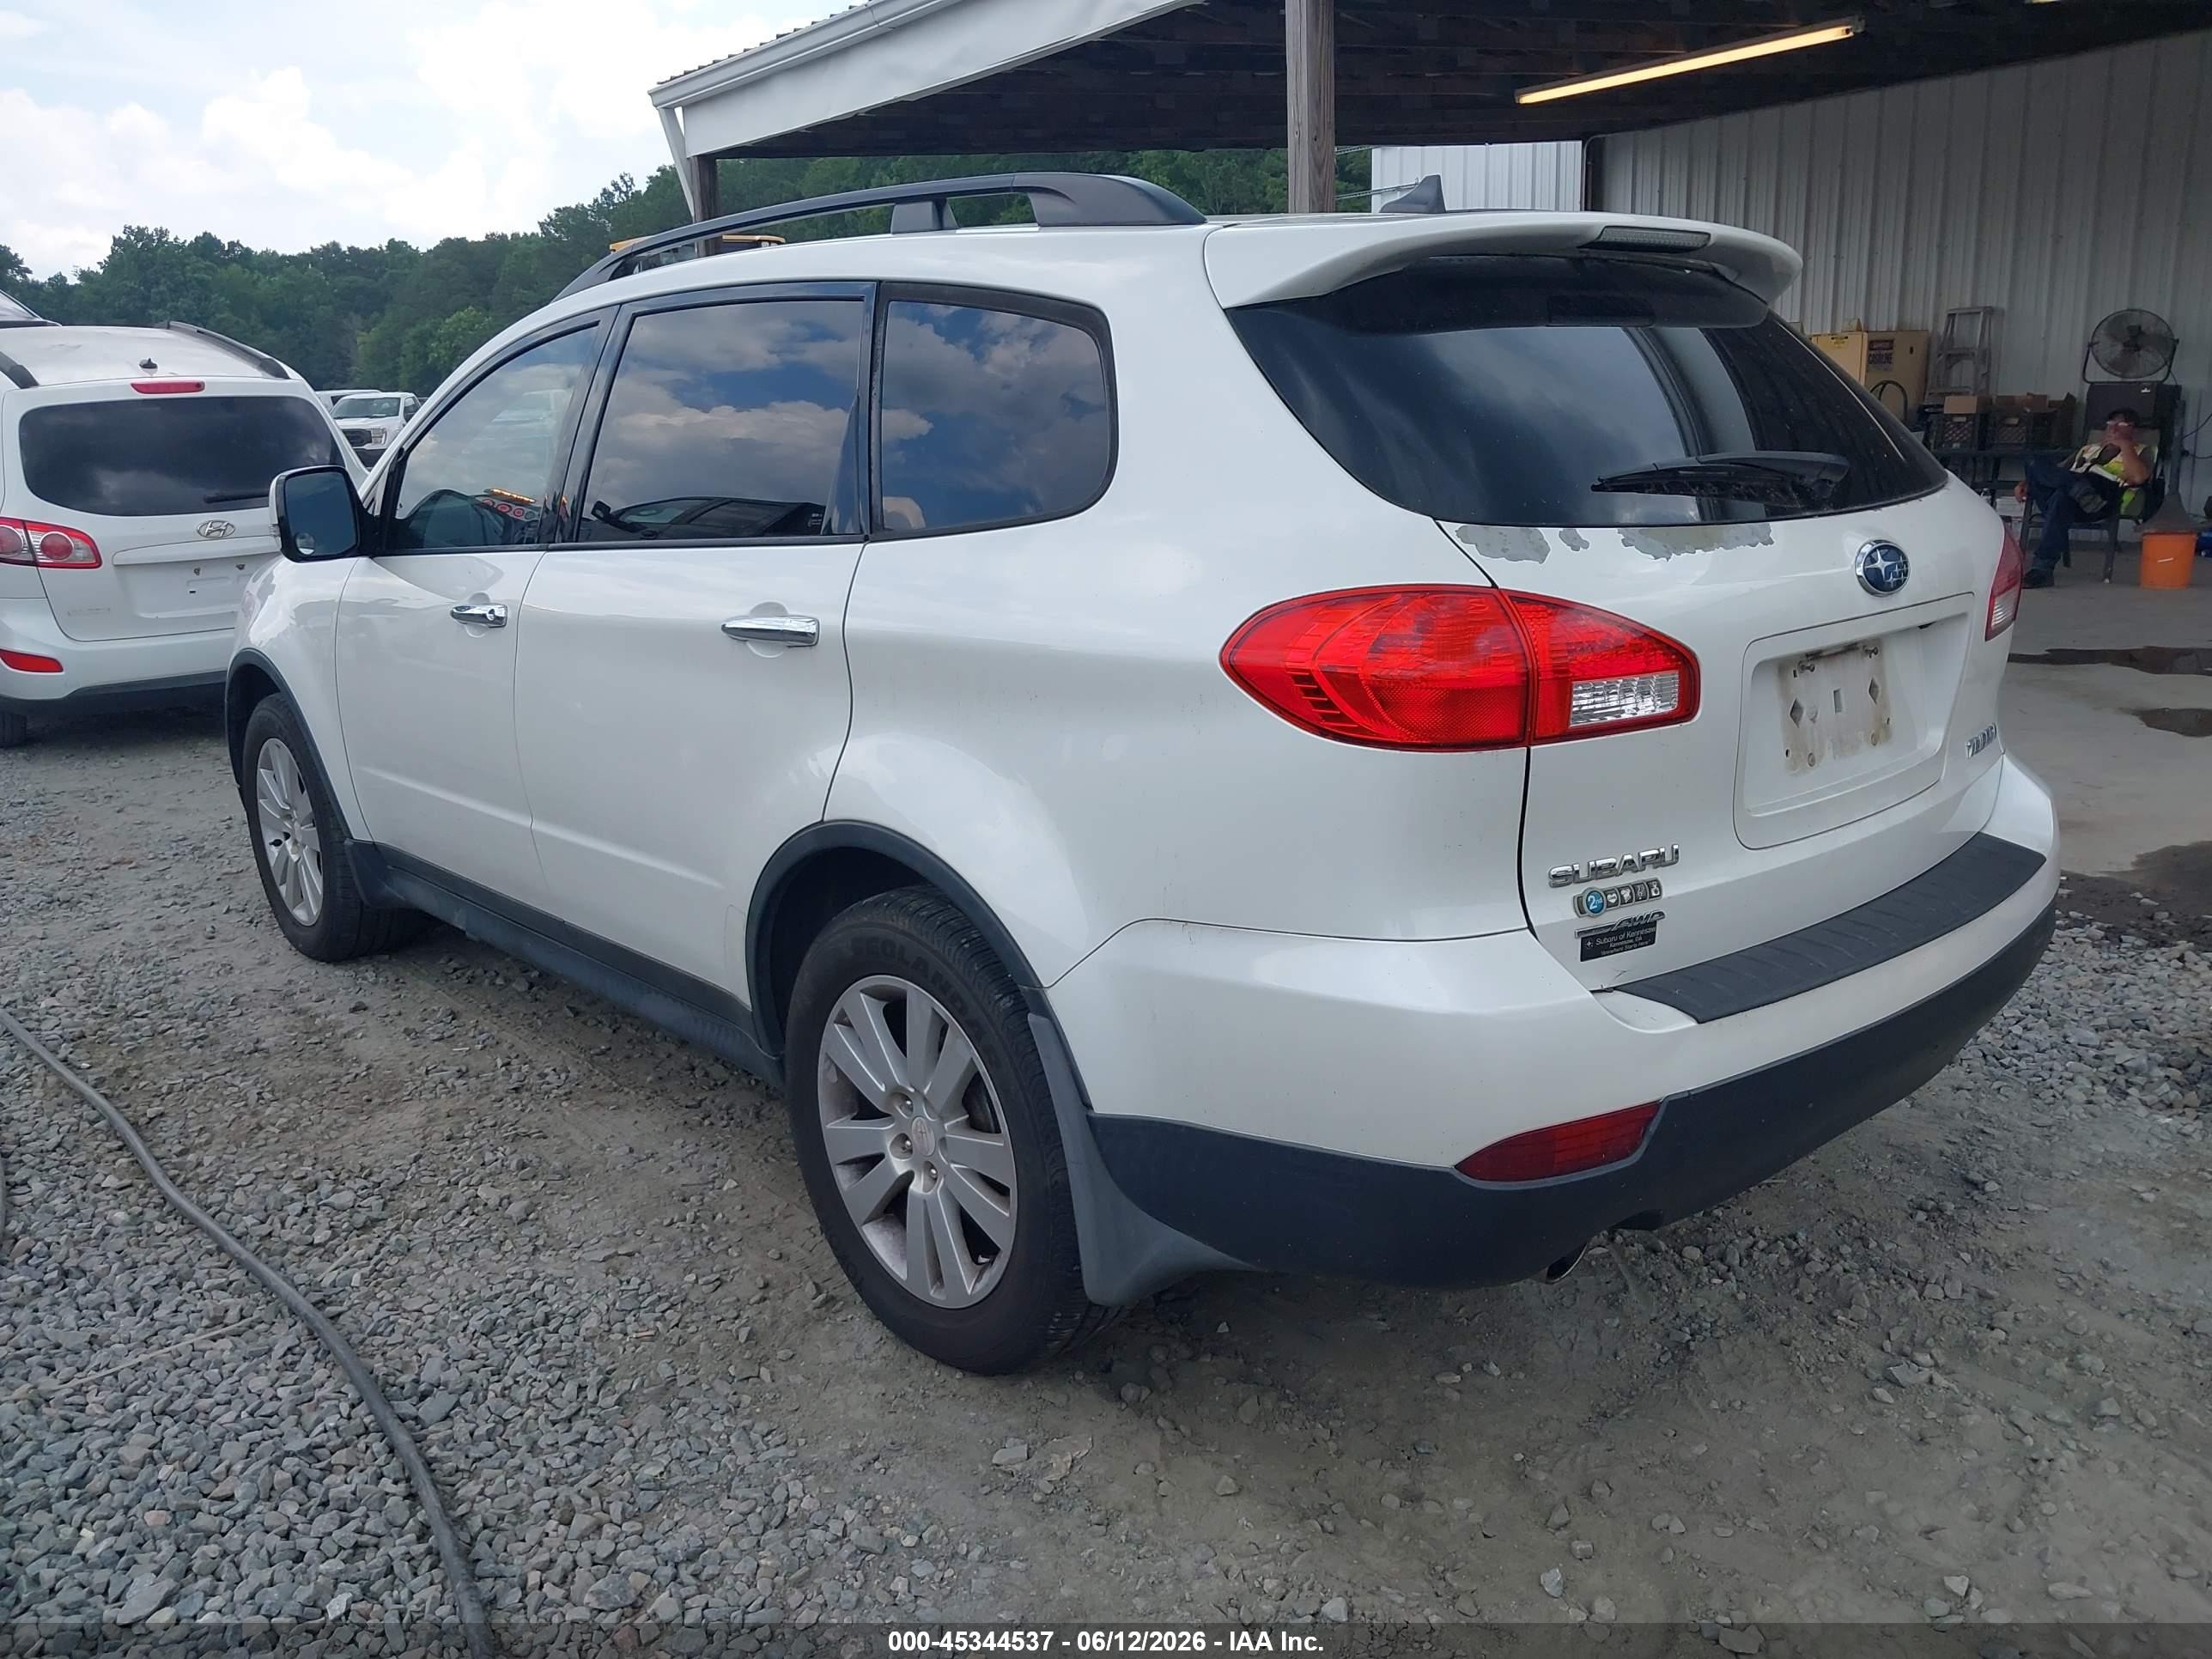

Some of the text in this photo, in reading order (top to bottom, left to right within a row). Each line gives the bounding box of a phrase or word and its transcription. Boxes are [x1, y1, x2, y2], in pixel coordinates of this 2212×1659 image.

[1548, 844, 1680, 888] SUBARU
[1595, 936, 1619, 946] Subaru
[1626, 927, 1656, 939] Kennesaw
